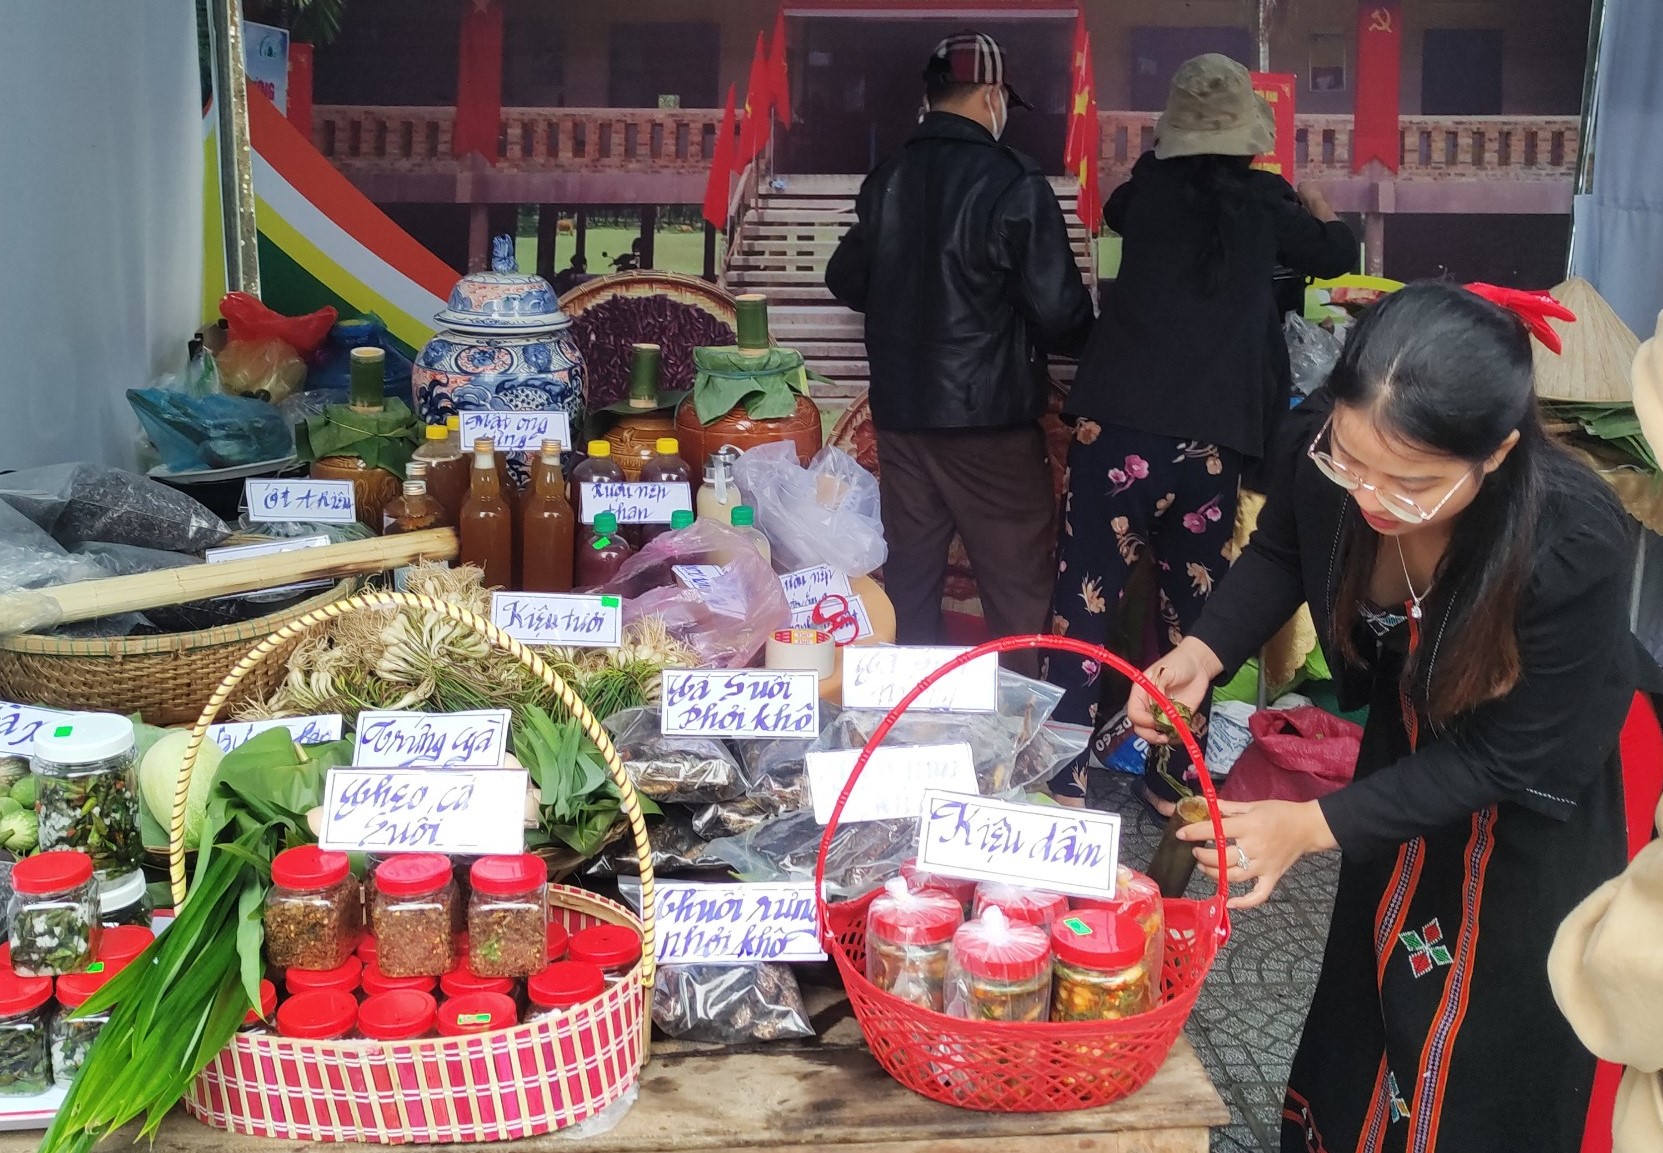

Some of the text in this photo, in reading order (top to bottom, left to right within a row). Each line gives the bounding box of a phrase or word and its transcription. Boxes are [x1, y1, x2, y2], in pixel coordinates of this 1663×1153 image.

[502, 600, 558, 637] Kiệu
[750, 702, 814, 731] khô
[930, 801, 1106, 868] Kiệu dầm
